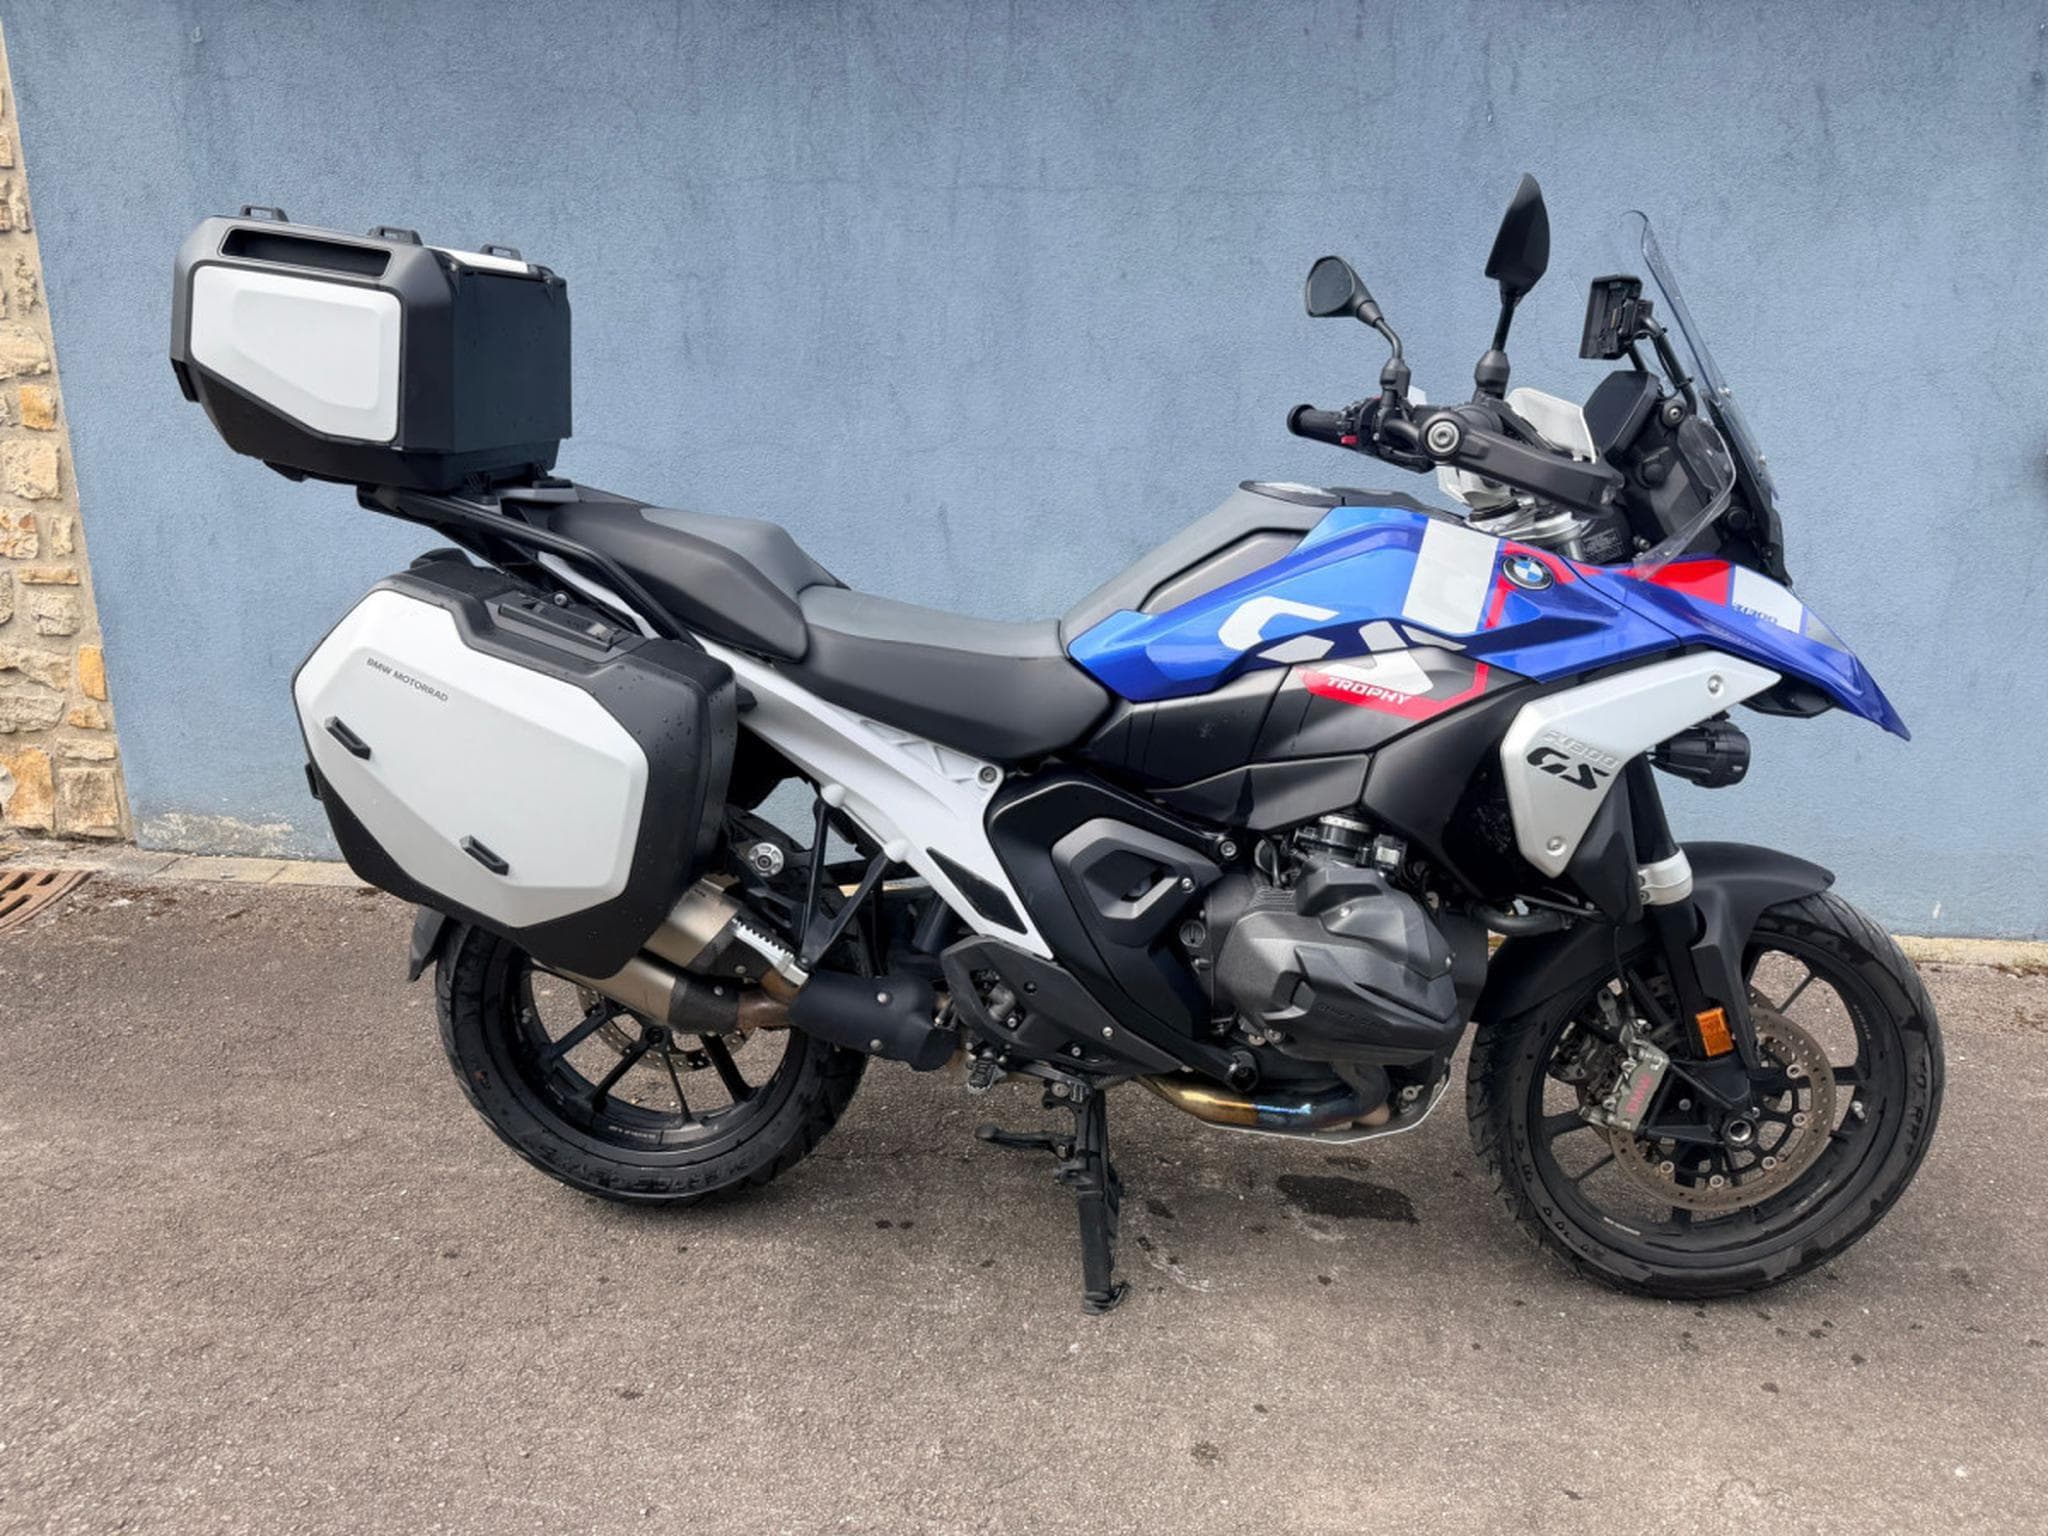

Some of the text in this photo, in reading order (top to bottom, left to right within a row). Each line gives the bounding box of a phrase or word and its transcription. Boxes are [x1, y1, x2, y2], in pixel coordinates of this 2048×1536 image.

[366, 657, 449, 702] BMW MOTORRAD
[1327, 675, 1413, 705] TROPHY
[1526, 746, 1611, 790] GS
